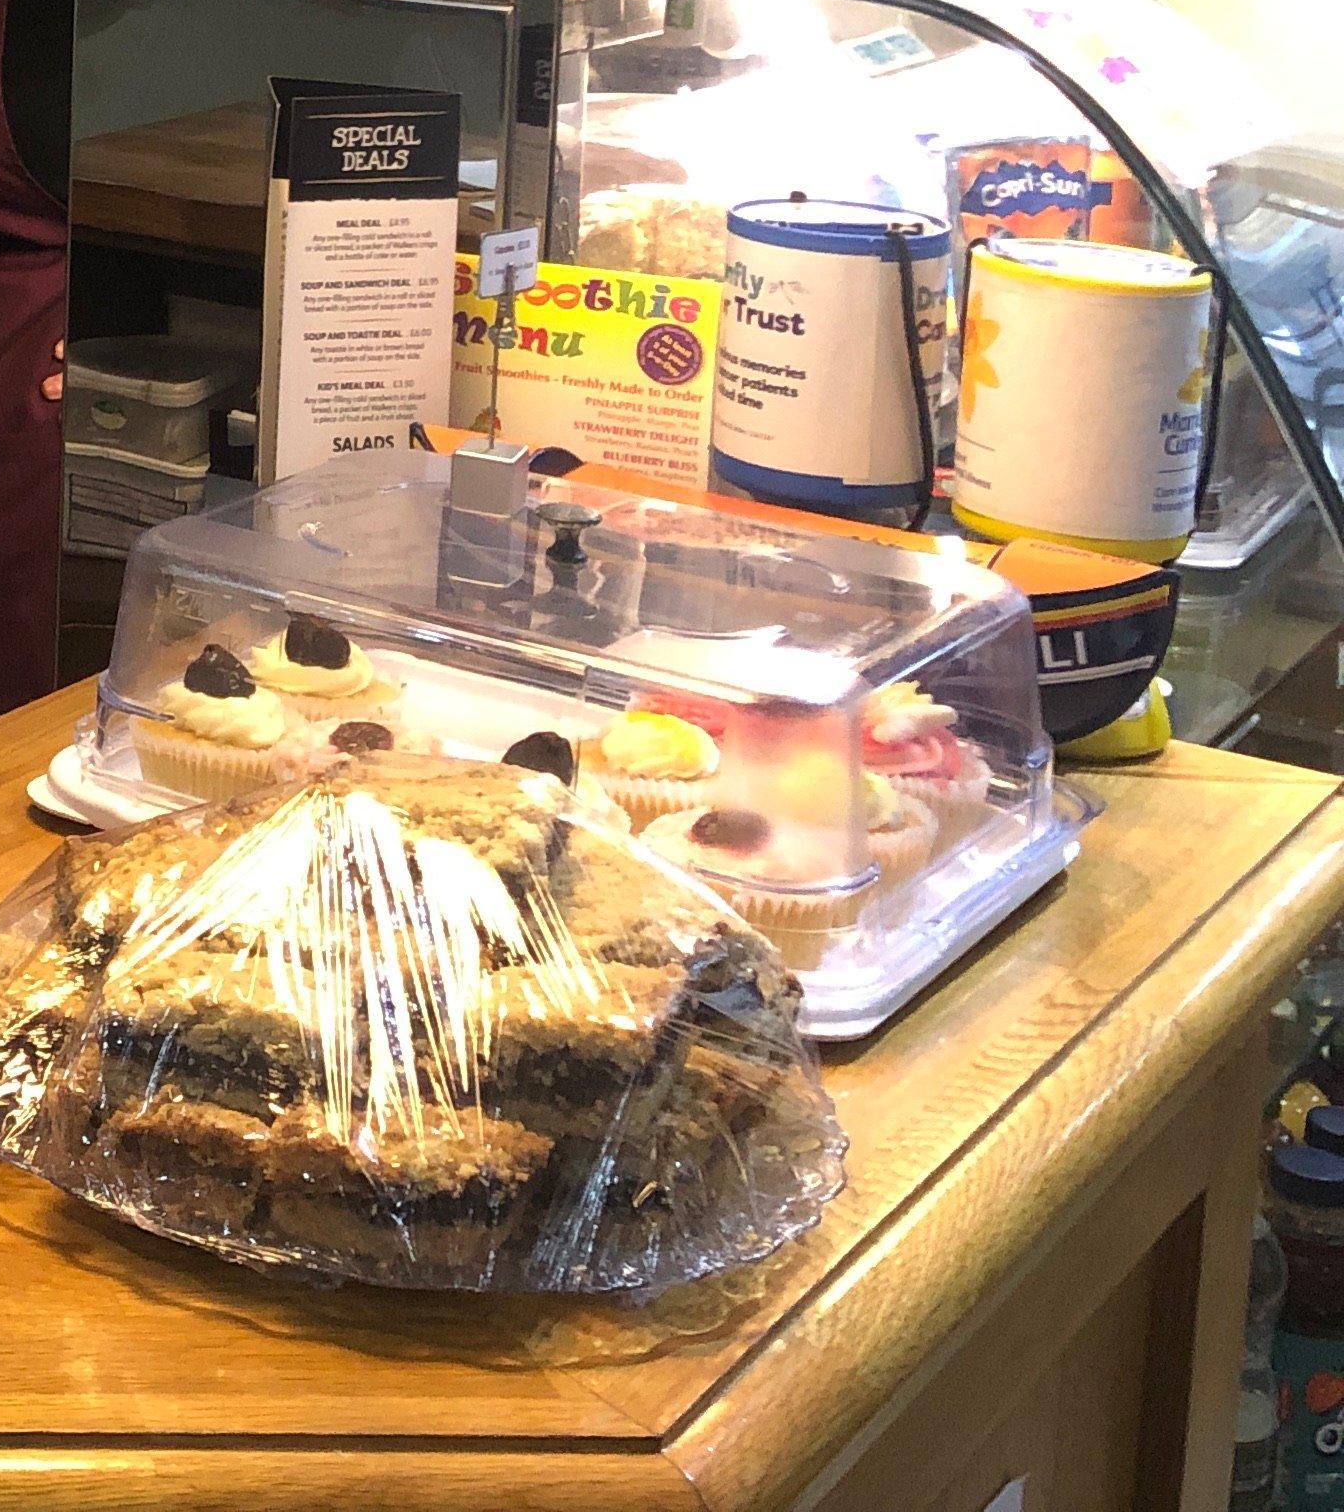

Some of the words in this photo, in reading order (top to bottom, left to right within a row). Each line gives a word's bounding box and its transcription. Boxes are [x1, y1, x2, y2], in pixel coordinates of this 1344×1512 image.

[332, 125, 422, 148] SPECIAL
[341, 149, 411, 172] DEALS
[336, 219, 359, 229] MEAL
[360, 219, 382, 228] DEAL
[300, 281, 324, 291] SOUP
[325, 280, 345, 290] AND
[344, 279, 390, 289] SANDWICH
[390, 278, 412, 288] DEAL
[454, 261, 703, 323] Soothie
[733, 295, 806, 337] Trust
[303, 331, 327, 342] SOUP
[327, 331, 347, 340] AND
[347, 330, 381, 340] TOASTIE
[381, 329, 403, 339] DEAL
[453, 311, 586, 359] menu
[739, 358, 807, 380] memories
[317, 382, 340, 392] KID'S
[340, 381, 364, 391] MEAL
[364, 381, 386, 390] DEAL
[561, 374, 607, 392] Freshly
[608, 380, 646, 396] Made
[647, 386, 662, 398] to
[663, 388, 704, 405] Order
[740, 377, 799, 399] patients
[584, 396, 643, 414] PINEAPPLE
[646, 404, 701, 421] SURPRISE
[736, 391, 764, 410] time
[331, 434, 396, 454] SALADS
[573, 420, 647, 440] STRAWBERRY
[648, 429, 701, 446] DELIGHT
[602, 449, 665, 467] BLUEBERRY
[667, 458, 699, 472] BLISS
